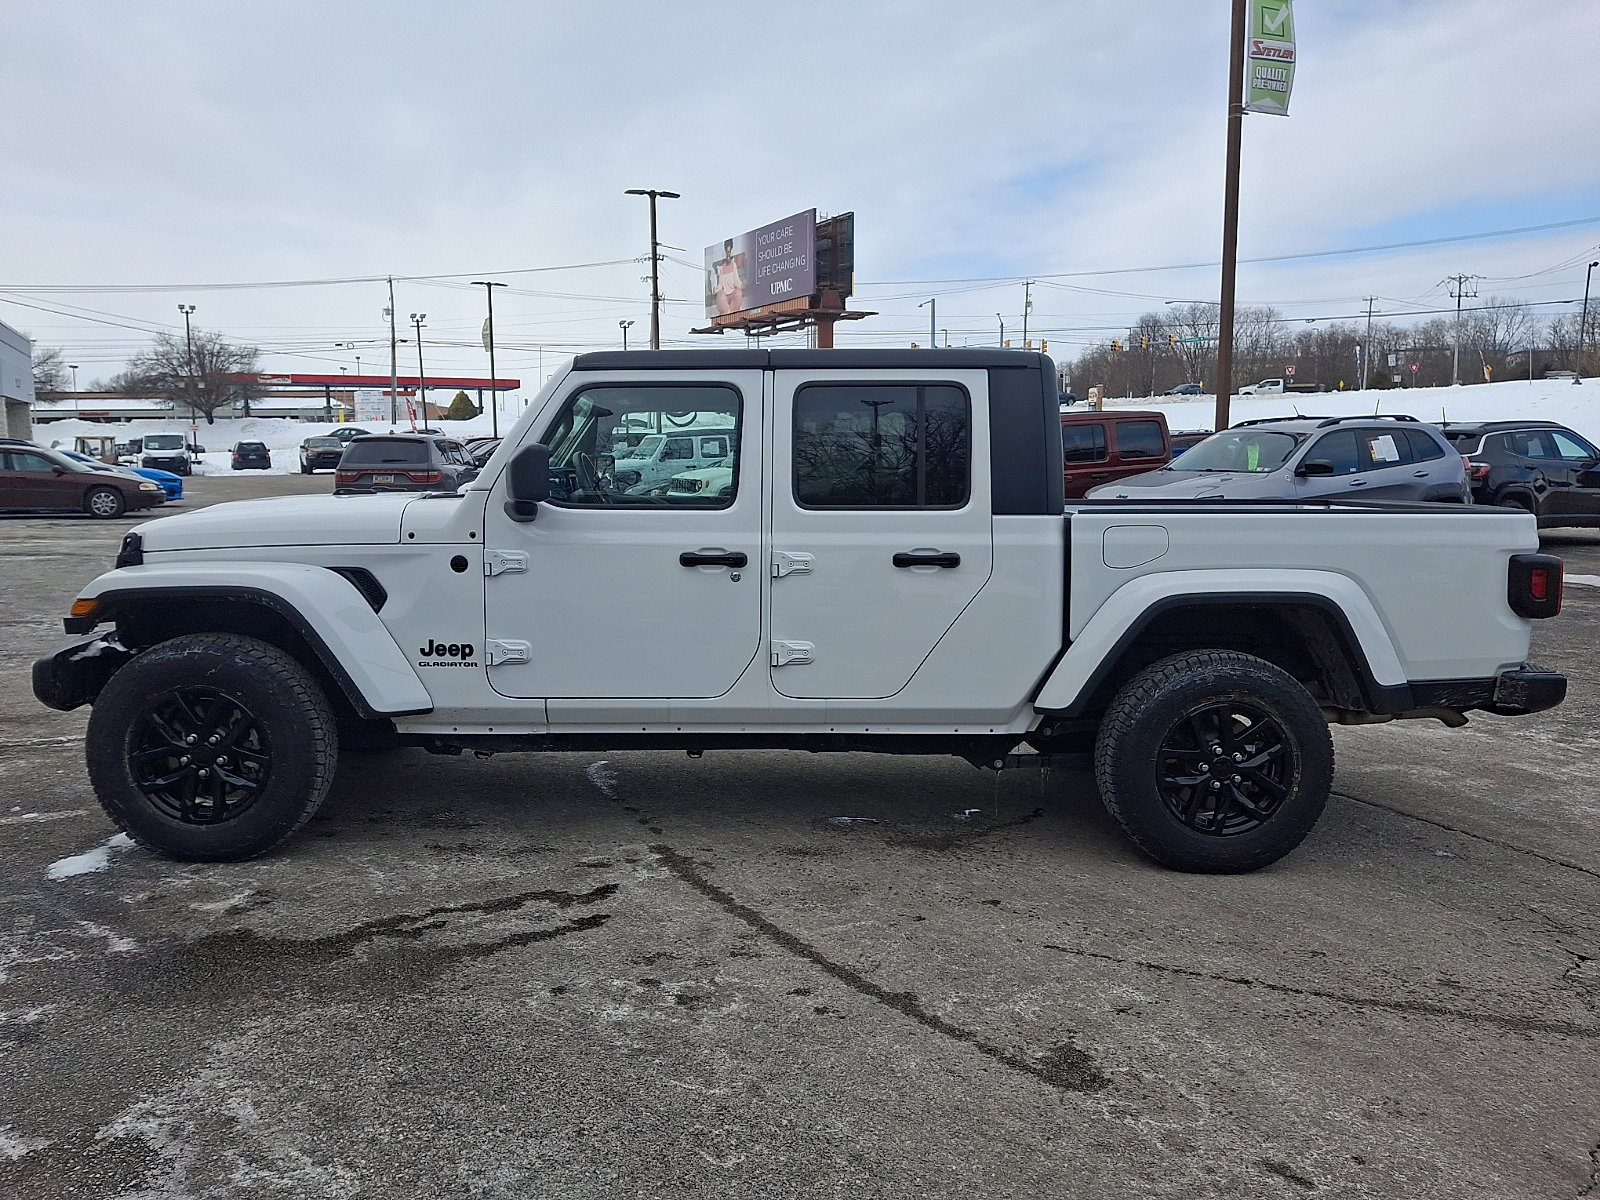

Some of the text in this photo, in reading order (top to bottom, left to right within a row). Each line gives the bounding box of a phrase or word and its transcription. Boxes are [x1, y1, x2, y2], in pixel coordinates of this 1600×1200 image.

[1256, 66, 1287, 81] QUALITY
[1252, 78, 1288, 92] PRE-OWNED
[758, 225, 793, 246] YOUR CARE
[758, 241, 793, 262] SHOULD BE
[758, 254, 806, 278] LIFE CHANGING
[770, 278, 793, 295] UPMC
[420, 639, 474, 660] Jeep
